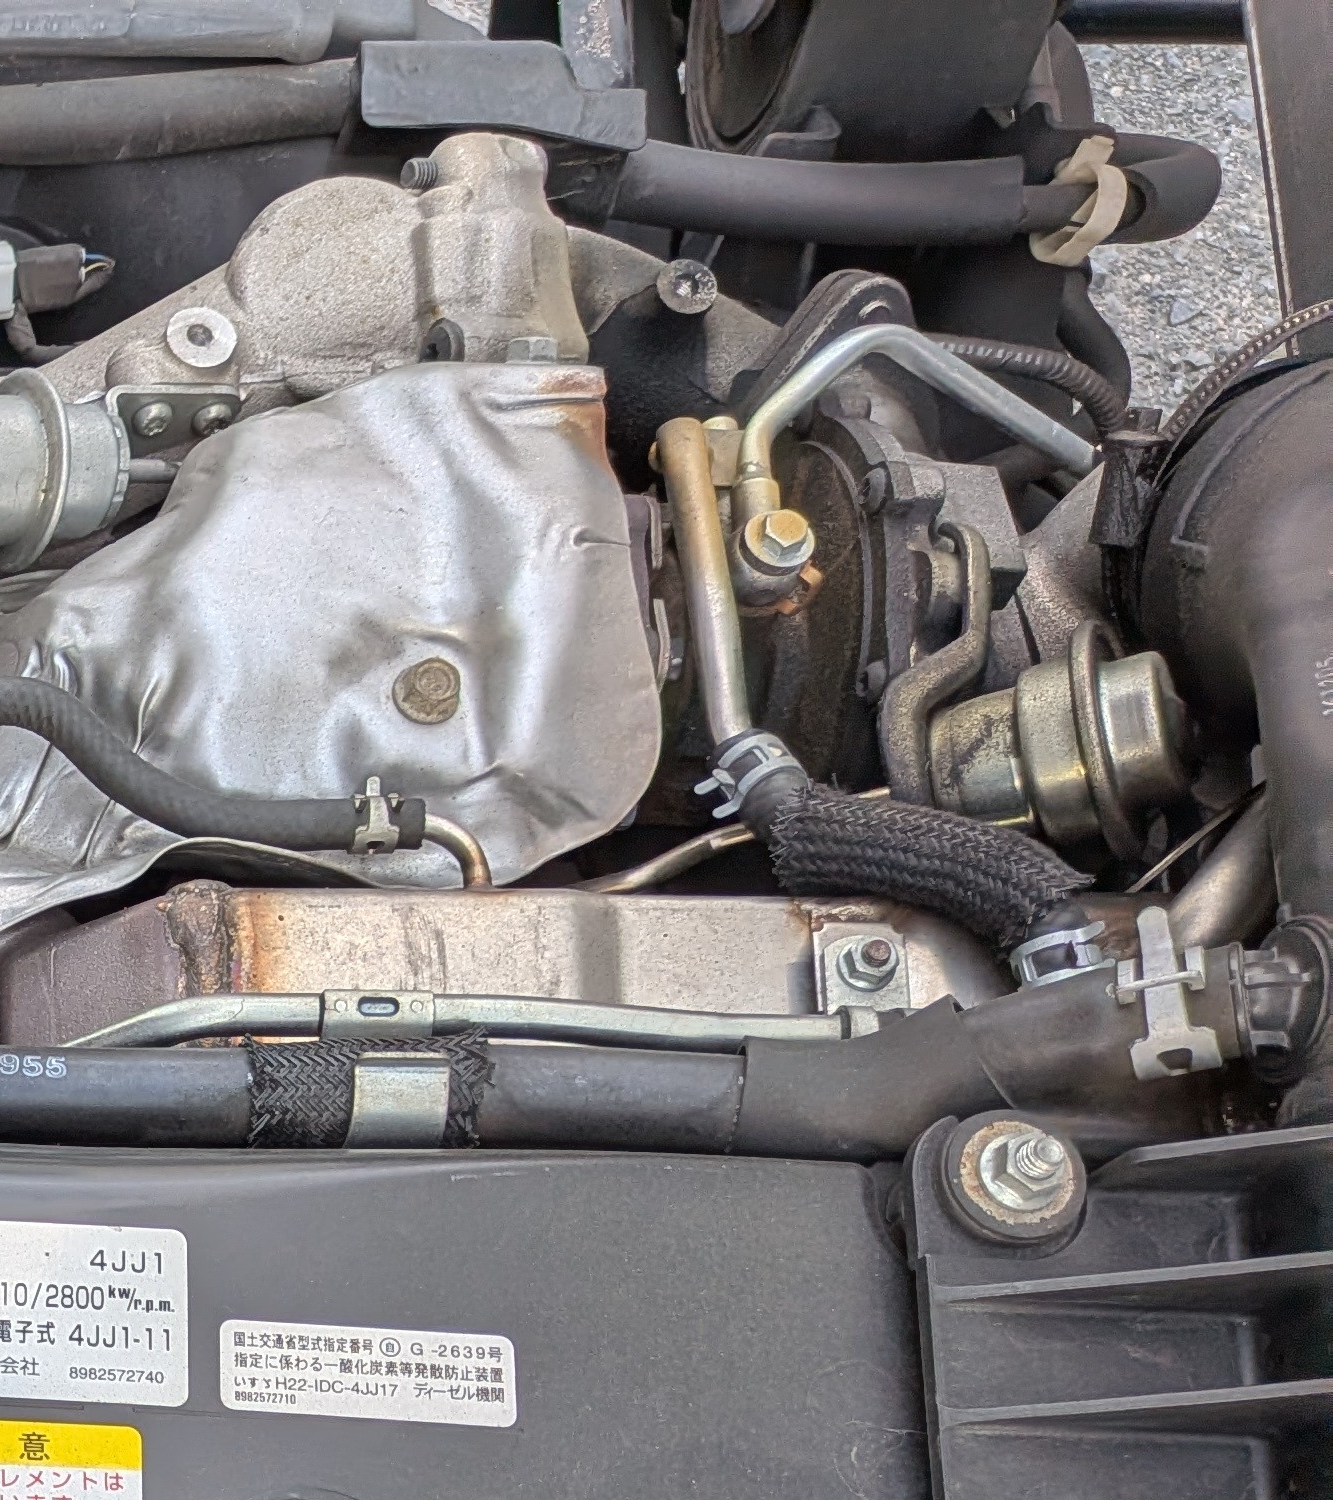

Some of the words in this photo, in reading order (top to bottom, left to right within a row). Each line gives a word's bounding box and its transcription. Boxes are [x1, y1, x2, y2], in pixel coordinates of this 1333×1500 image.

[0, 1053, 67, 1079] 955
[89, 1249, 163, 1275] 4JJ1
[69, 1324, 172, 1352] 4JJ1-11
[234, 1331, 373, 1355] 国土交通省型式指定番号
[69, 1365, 165, 1385] 8982572740
[234, 1352, 504, 1383] 指定に係わる一酸化炭素等発散防止装置
[235, 1391, 296, 1404] 8982572710
[413, 1382, 504, 1403] ディーゼル機関
